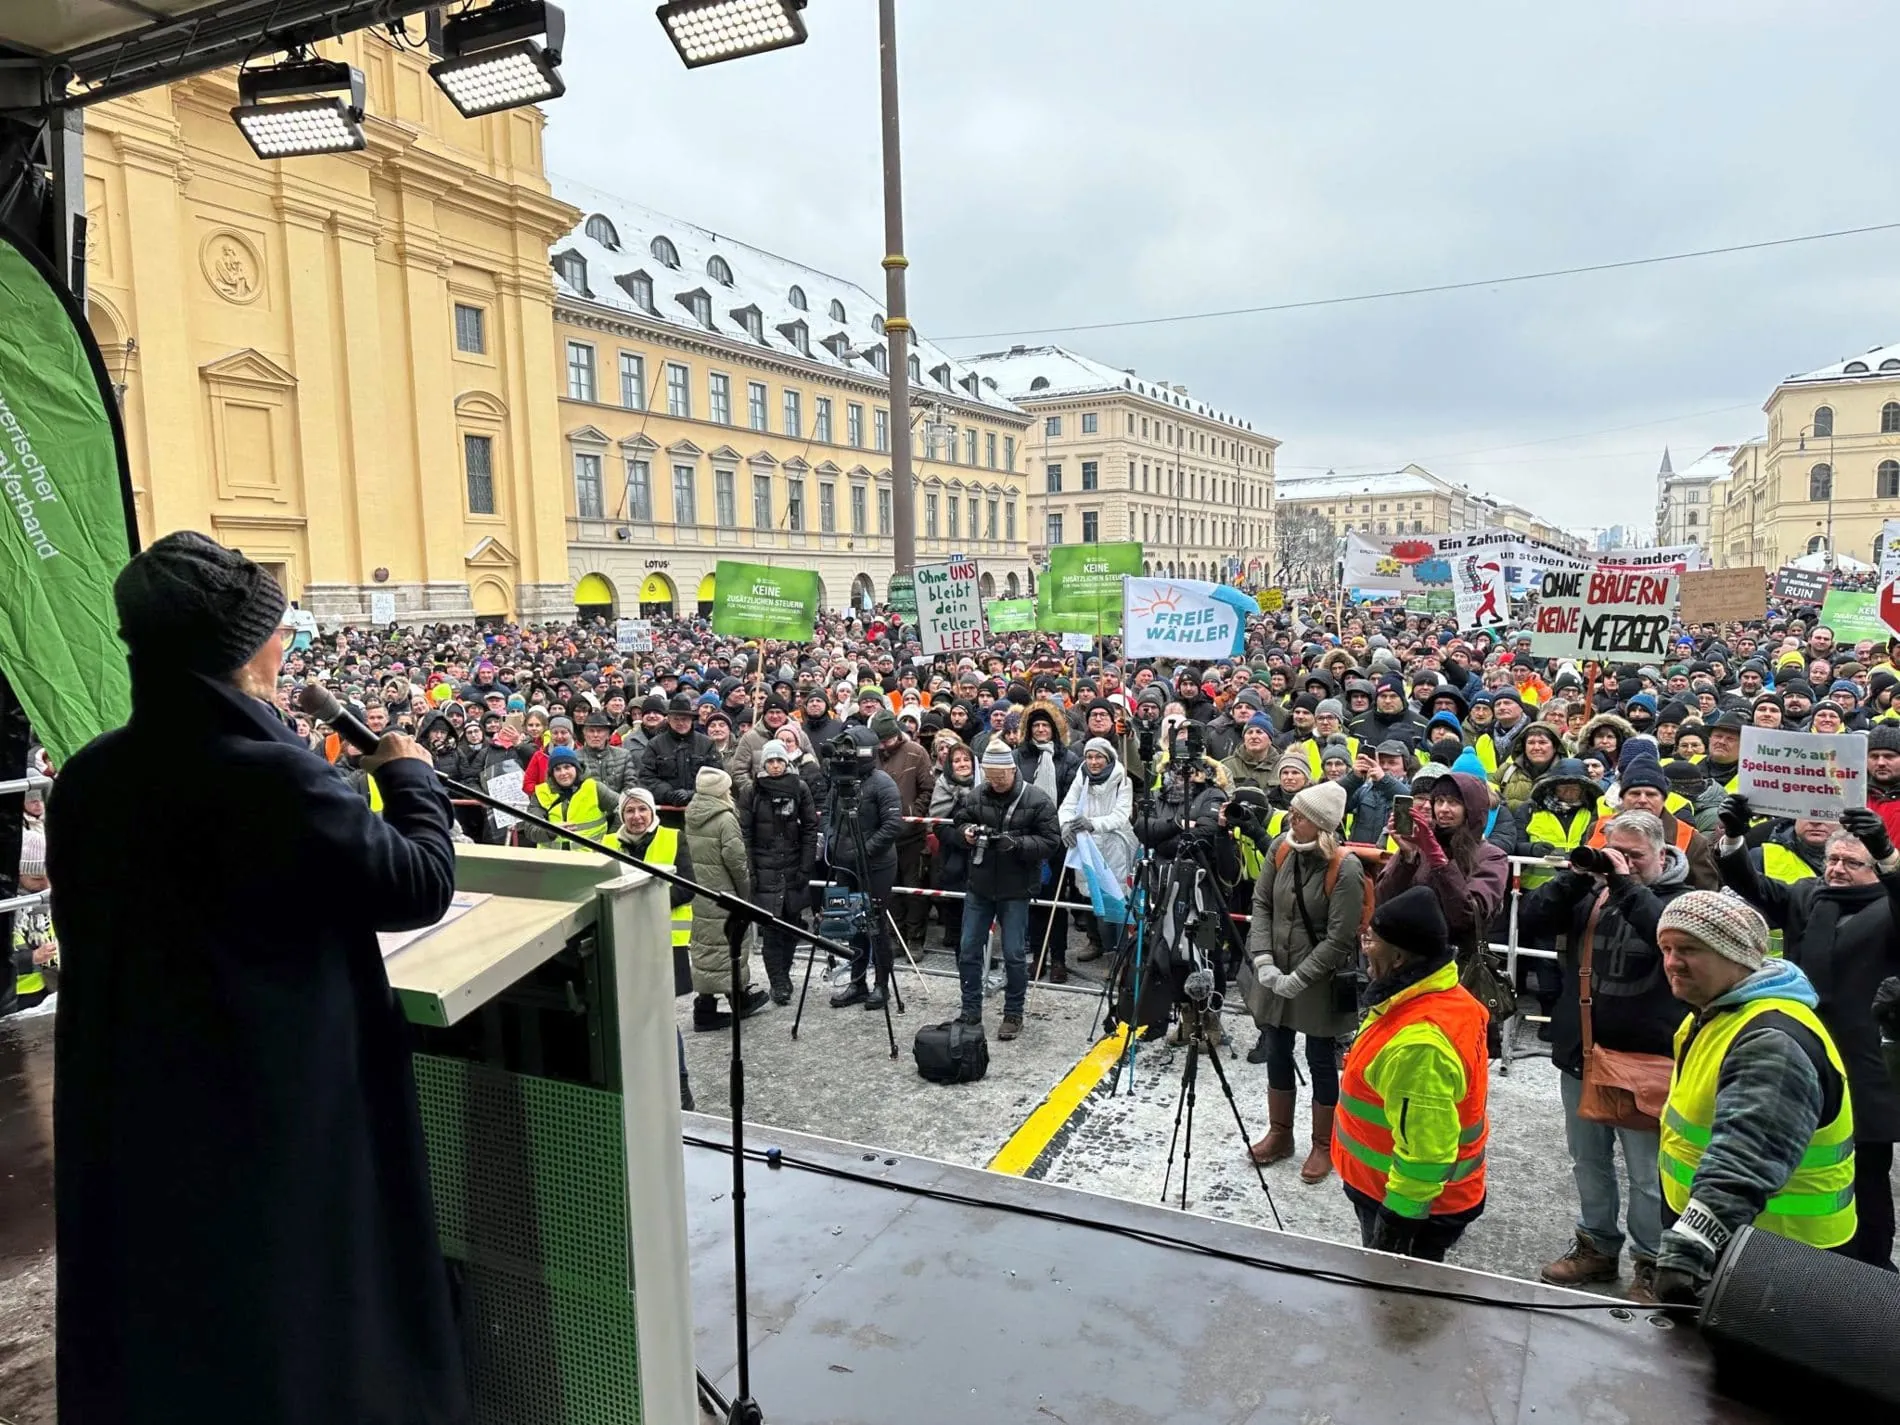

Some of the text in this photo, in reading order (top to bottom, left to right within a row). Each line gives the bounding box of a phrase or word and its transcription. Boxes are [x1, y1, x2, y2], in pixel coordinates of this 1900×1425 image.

[0, 392, 57, 502] yerischer
[1439, 539, 1462, 549] Ein
[1467, 533, 1526, 546] Zahnrad
[1598, 557, 1627, 565] das
[644, 560, 668, 568] LOTUS
[1083, 563, 1110, 573] KEINE
[1519, 552, 1564, 567] stehen
[1568, 561, 1590, 571] wir
[918, 563, 976, 584] Ohne UNS
[1505, 566, 1523, 583] IE
[752, 584, 781, 598] KEINE
[929, 581, 970, 601] bleibt
[1542, 572, 1584, 598] OHNE
[1587, 573, 1669, 605] BAUERN
[1784, 586, 1814, 599] RUIN
[726, 594, 804, 609] ZUSÄTZLICHEN STEUERN
[936, 601, 967, 614] dein
[1155, 608, 1215, 626] FREIE
[1858, 607, 1876, 615] KEI
[930, 617, 976, 633] Teller
[1146, 624, 1229, 643] WÄHLER
[1537, 606, 1670, 654] KEINE METZGER
[940, 629, 982, 650] LEER
[1757, 744, 1836, 760] Nur 7% auf
[1742, 759, 1859, 779] Speisen sind fair
[1753, 778, 1842, 795] und gerecht
